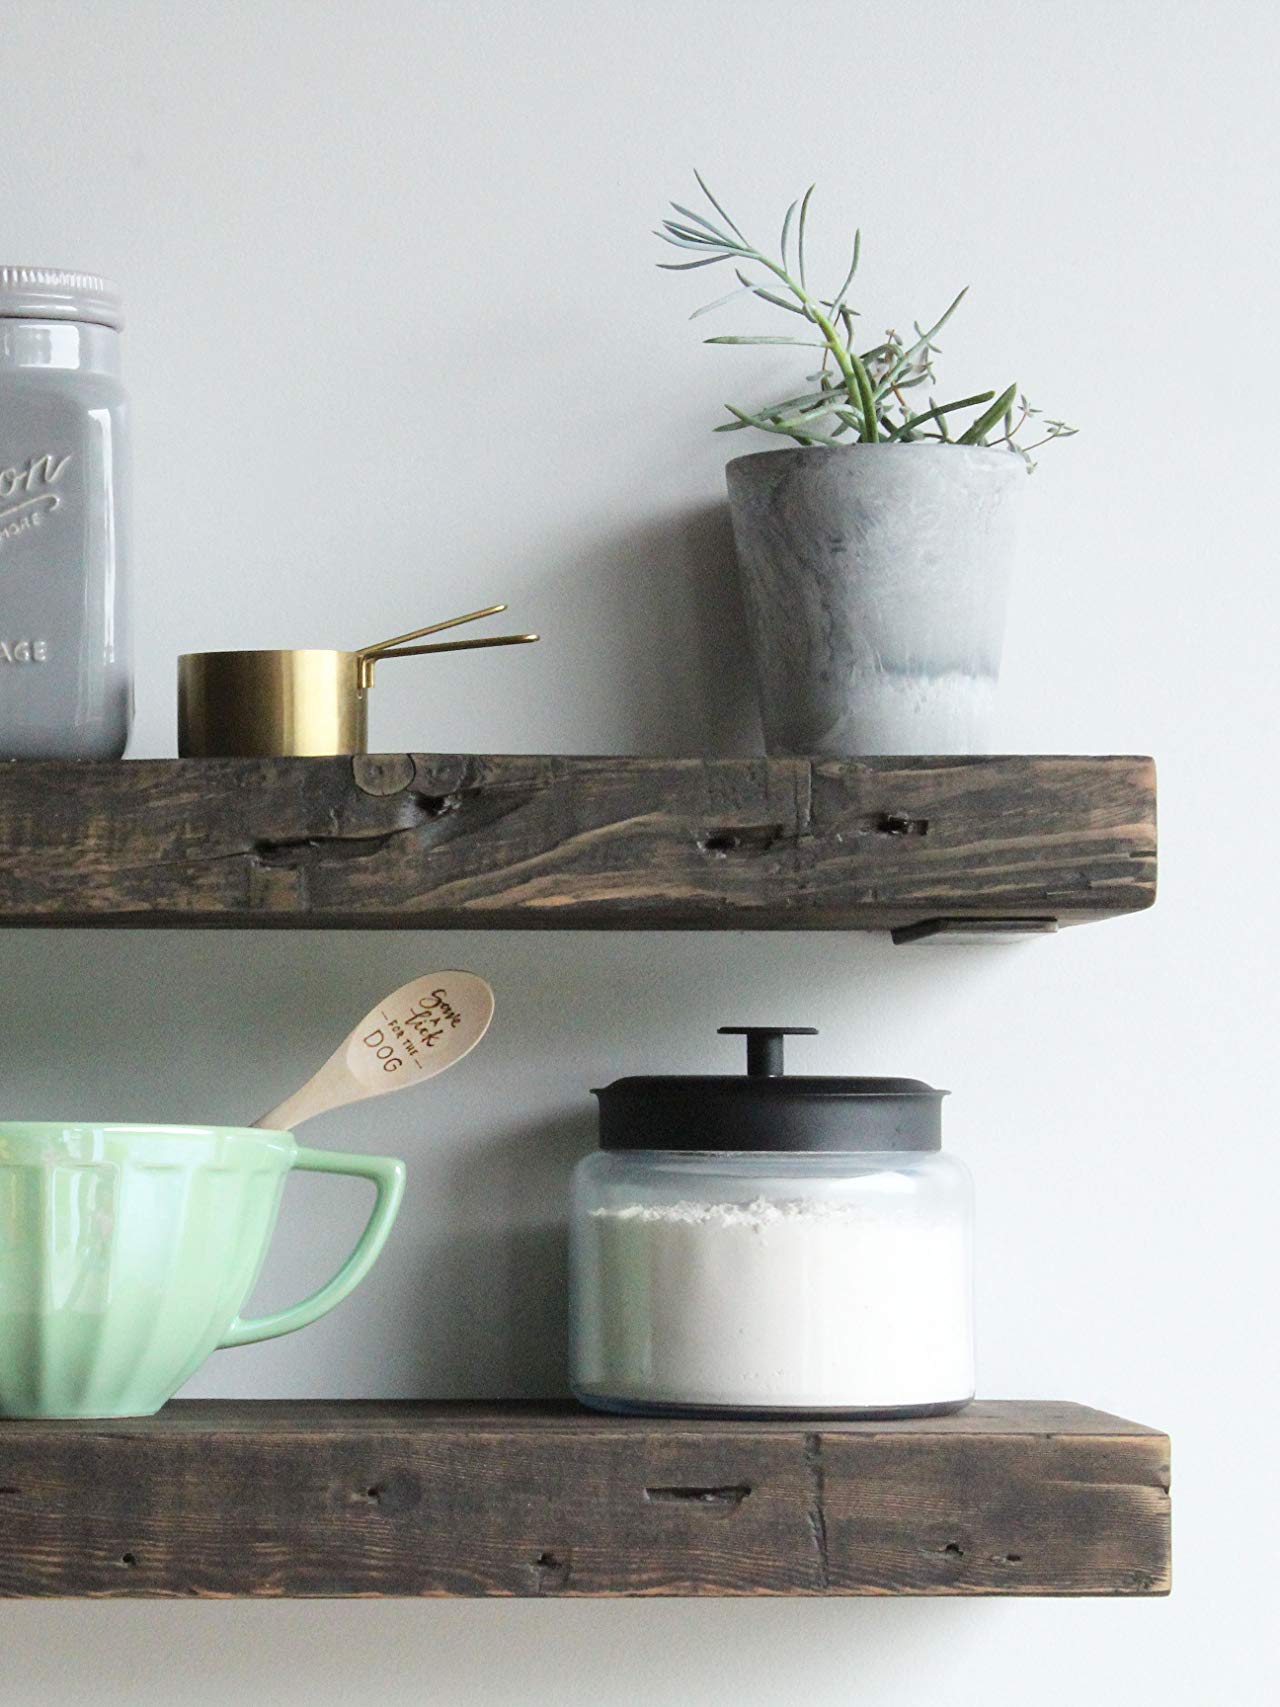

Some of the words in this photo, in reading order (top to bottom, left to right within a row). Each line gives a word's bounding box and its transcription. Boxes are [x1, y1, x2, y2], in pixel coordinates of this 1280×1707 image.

[418, 988, 462, 1029] Save
[363, 1029, 403, 1073] DOG
[387, 1019, 405, 1040] FOR
[402, 1038, 419, 1056] THE
